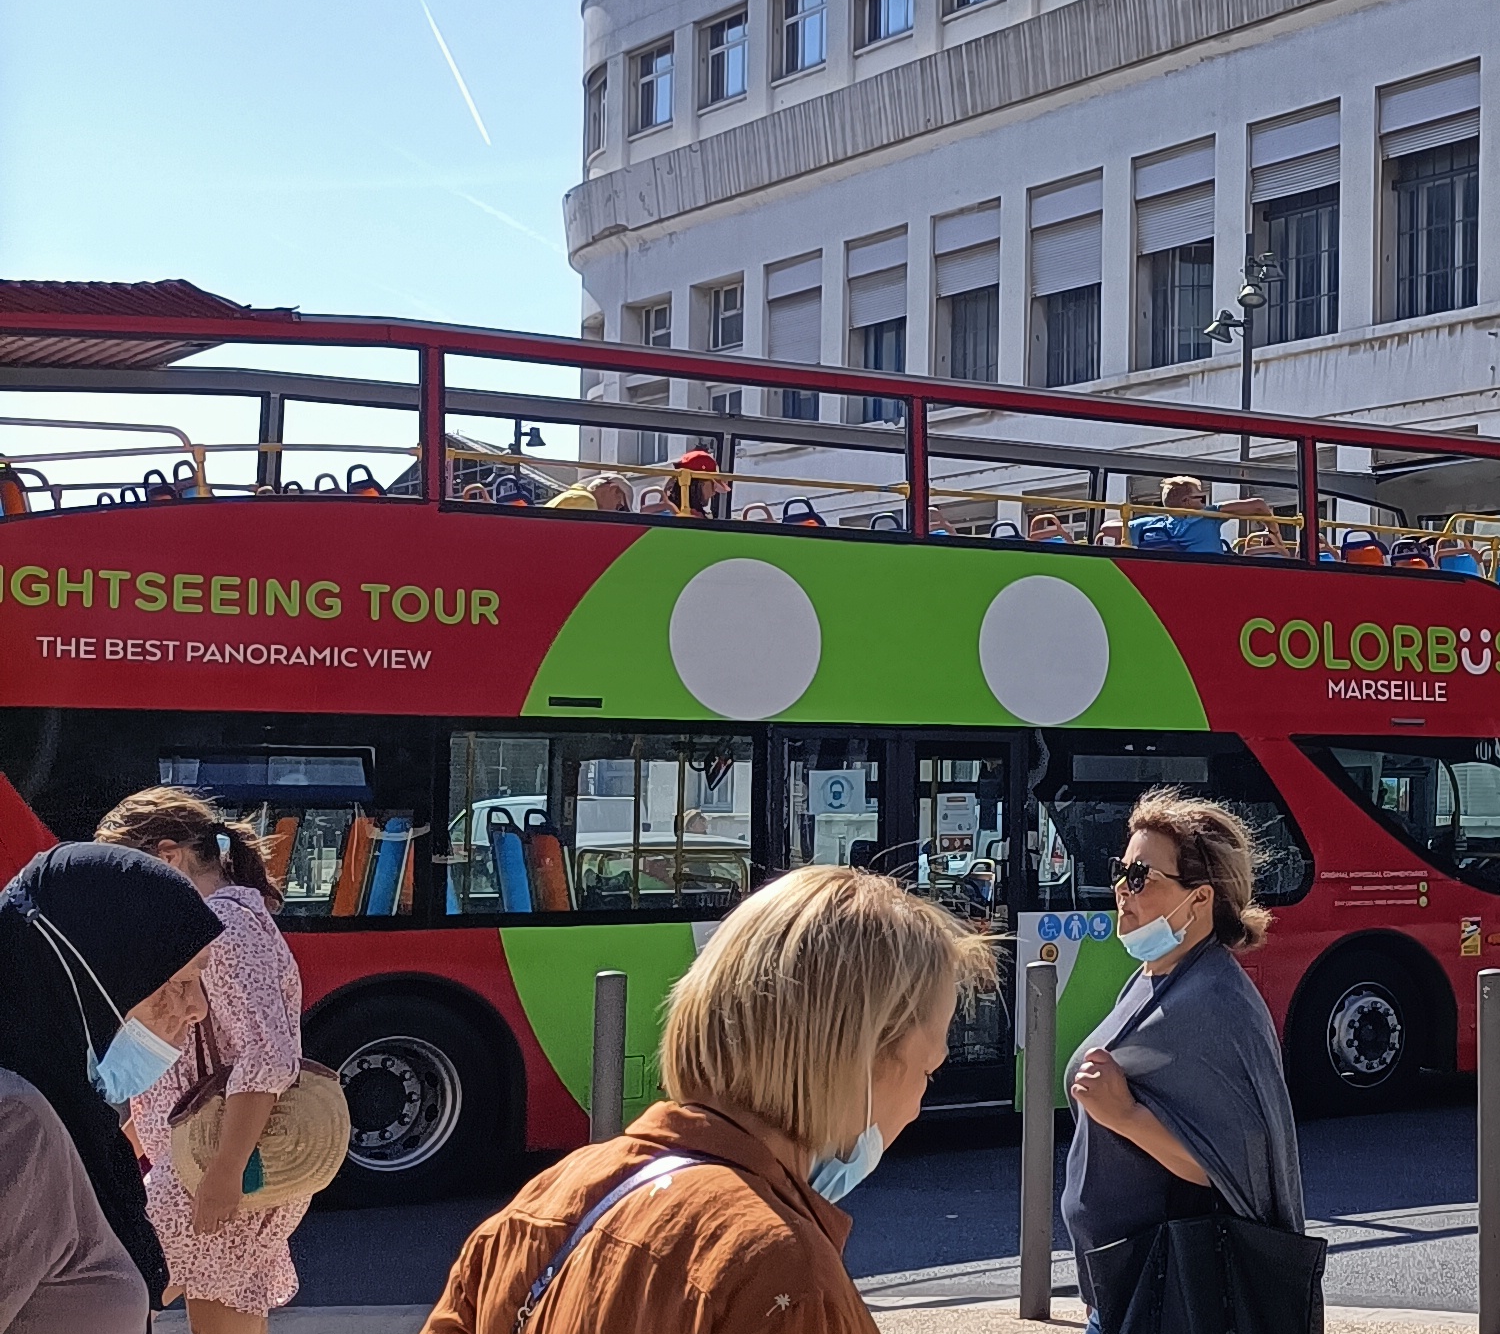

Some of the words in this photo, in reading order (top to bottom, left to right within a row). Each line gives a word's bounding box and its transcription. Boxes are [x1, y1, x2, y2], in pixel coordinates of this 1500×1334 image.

[360, 583, 500, 625] TOUR
[36, 636, 97, 659] THE
[105, 638, 180, 661] BEST
[186, 641, 358, 667] PANORAMIC
[363, 648, 432, 670] VIEW
[1328, 679, 1447, 702] MARSEILLE
